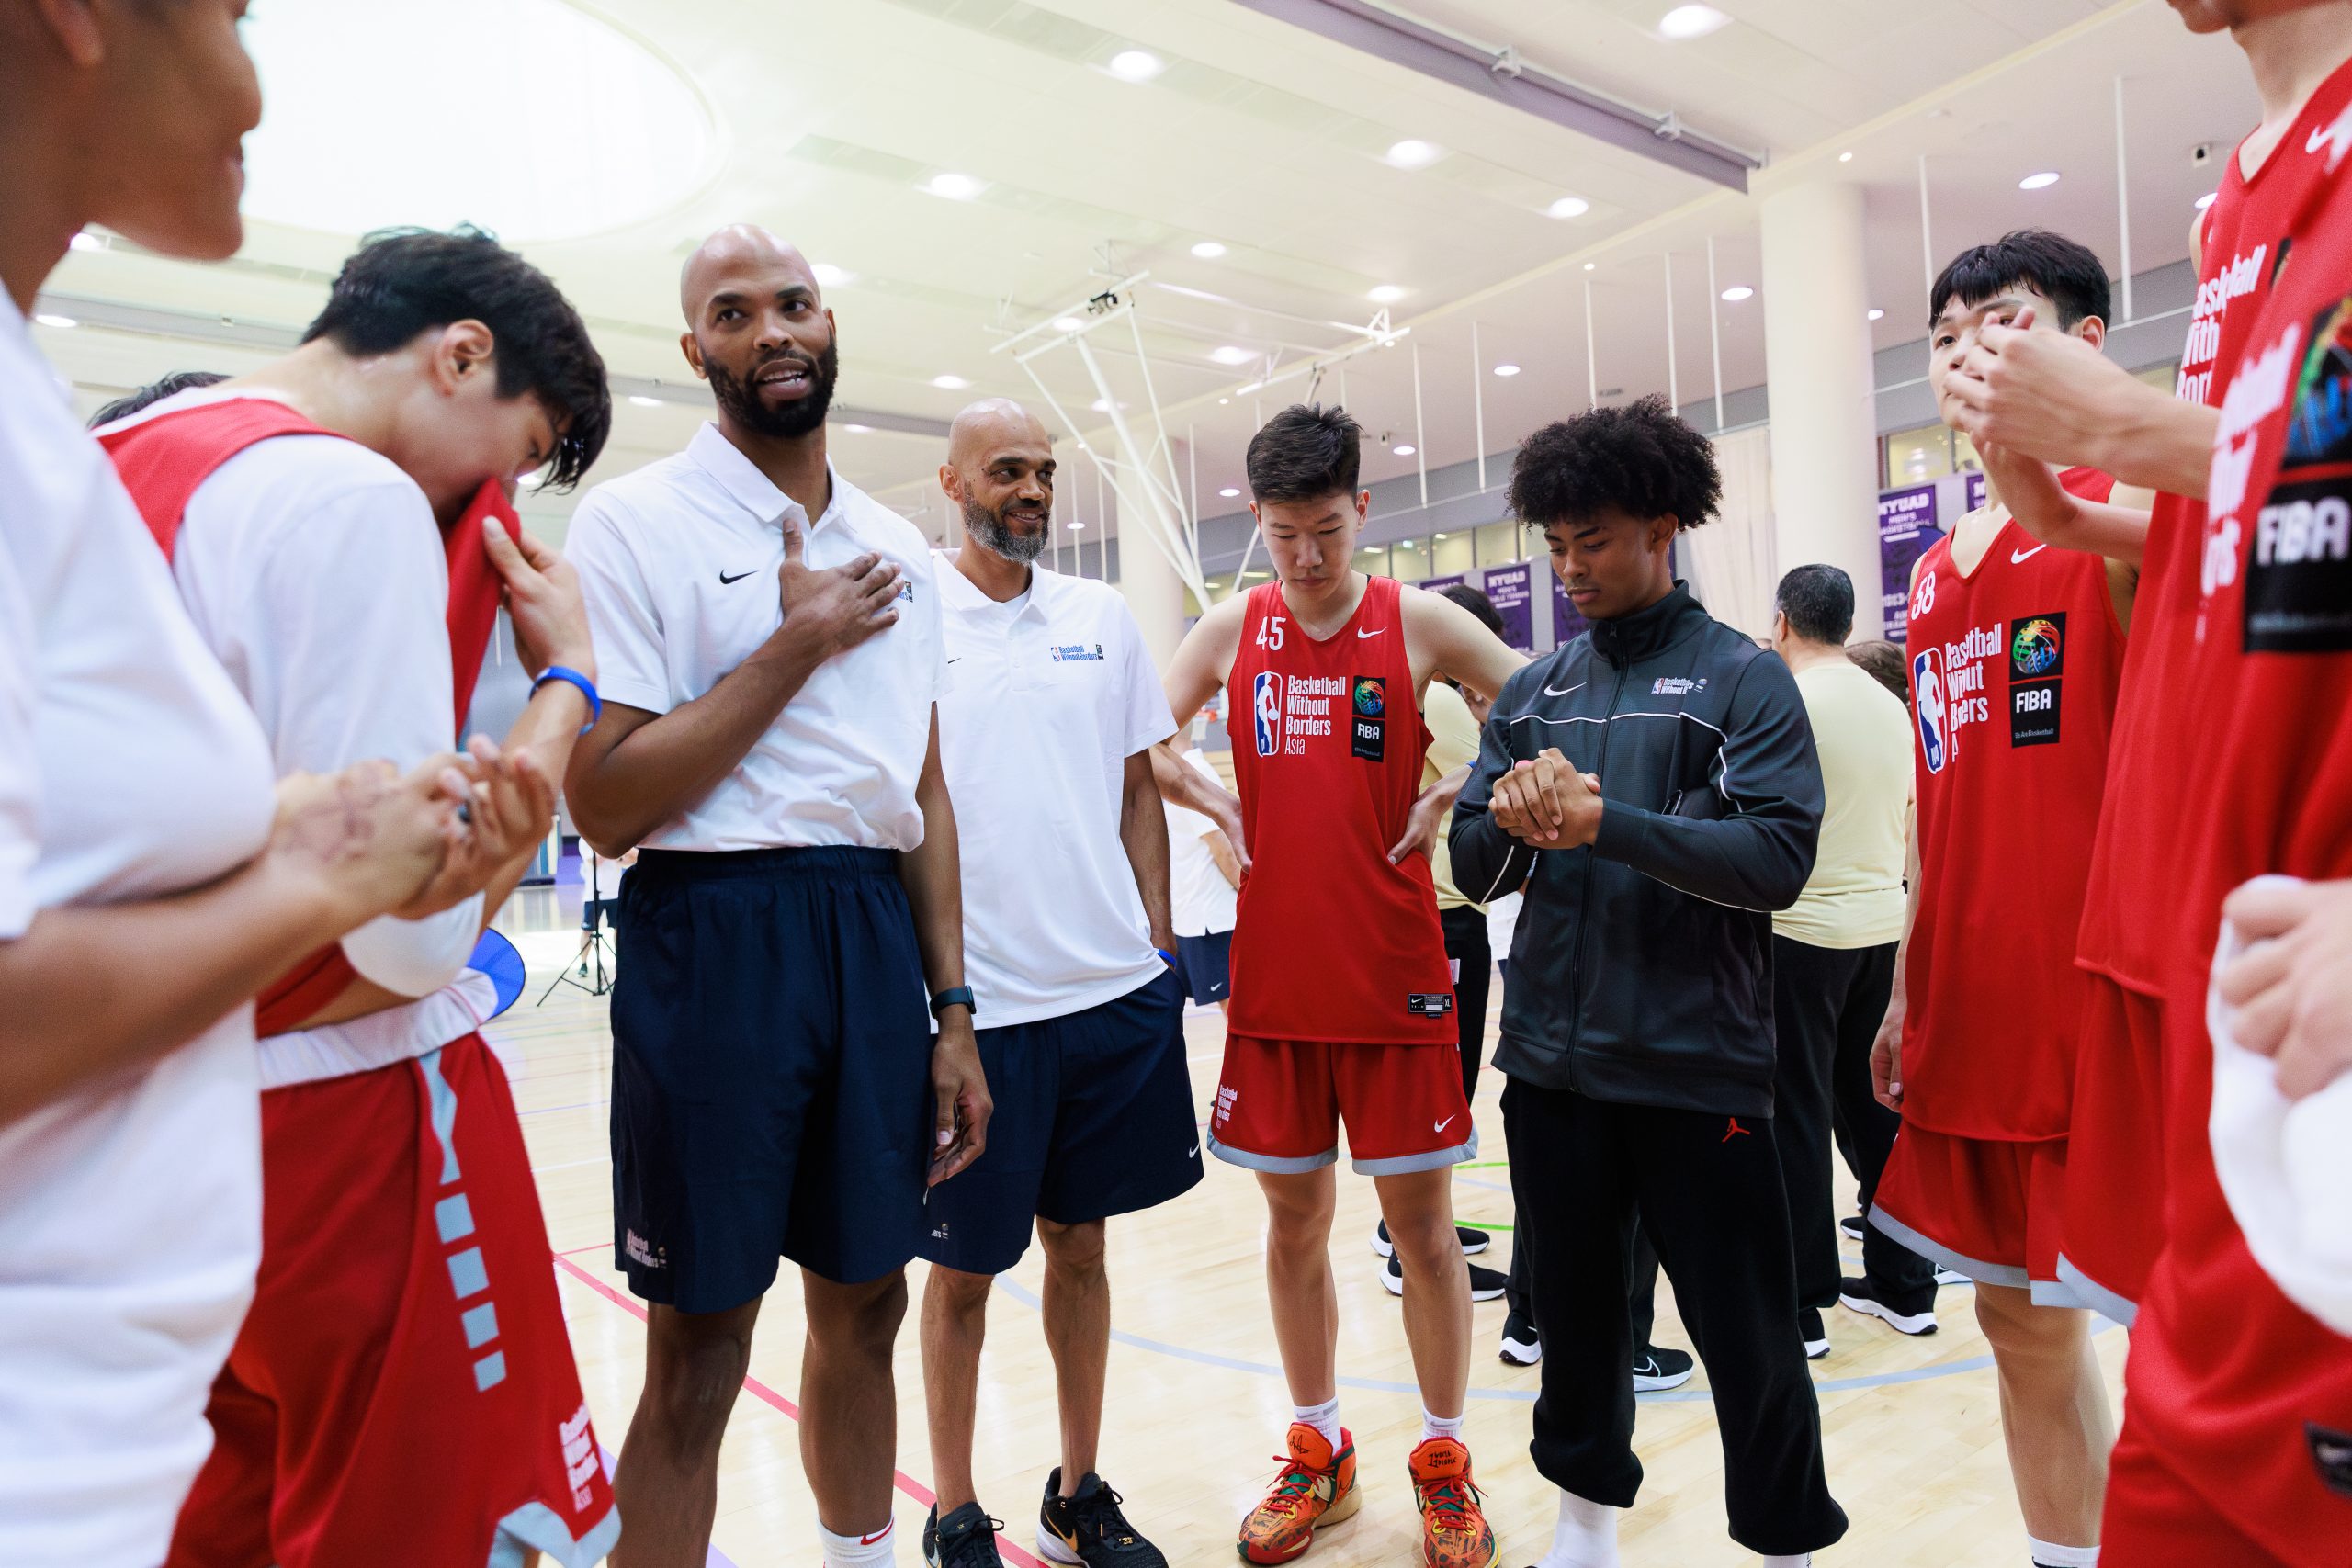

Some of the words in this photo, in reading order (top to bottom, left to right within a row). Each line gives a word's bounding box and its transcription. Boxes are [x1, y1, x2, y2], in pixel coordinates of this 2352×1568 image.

[1911, 570, 1936, 620] 58
[1256, 616, 1286, 650] 45
[1288, 675, 1346, 695] Basketball
[1287, 694, 1329, 716] Without
[2016, 688, 2052, 714] FIBA
[1286, 715, 1331, 736] Borders
[1358, 723, 1380, 740] FIBA
[1284, 735, 1306, 755] Asia
